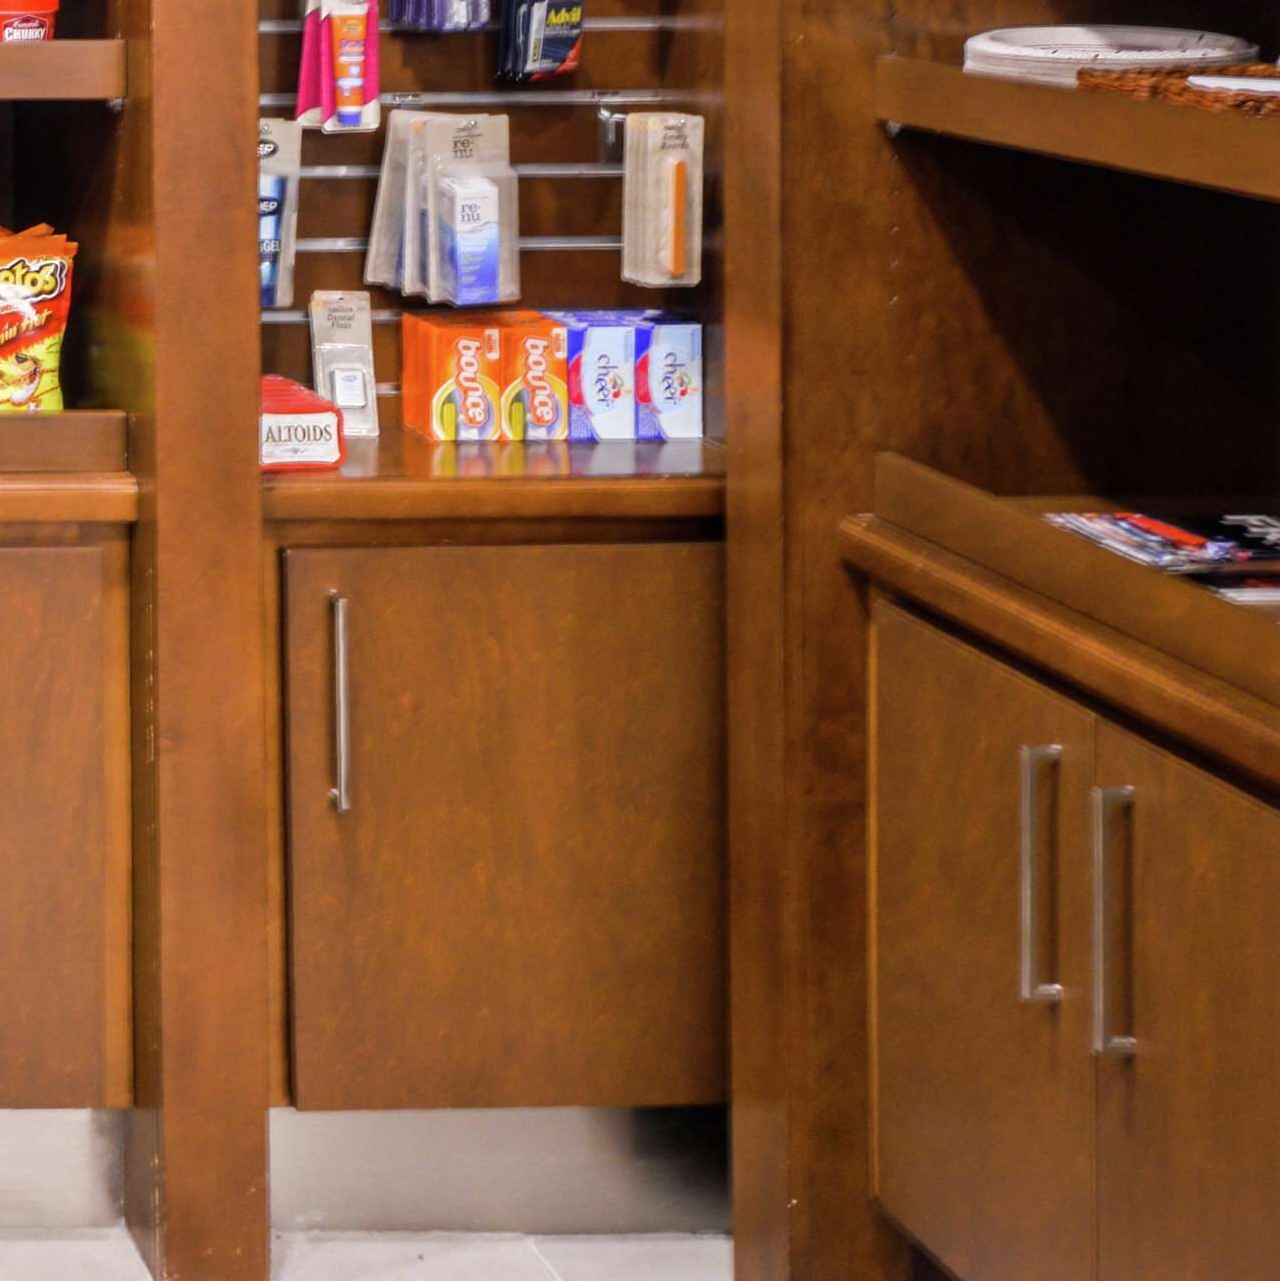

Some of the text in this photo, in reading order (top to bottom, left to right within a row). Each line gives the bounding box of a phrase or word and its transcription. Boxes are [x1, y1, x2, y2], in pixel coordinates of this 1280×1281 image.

[4, 26, 46, 41] CHUNKY
[457, 338, 486, 421] bounce
[525, 337, 555, 420] bounce
[597, 354, 619, 407] cheer
[664, 352, 686, 406] cheer
[264, 424, 333, 443] ALTOIDS
